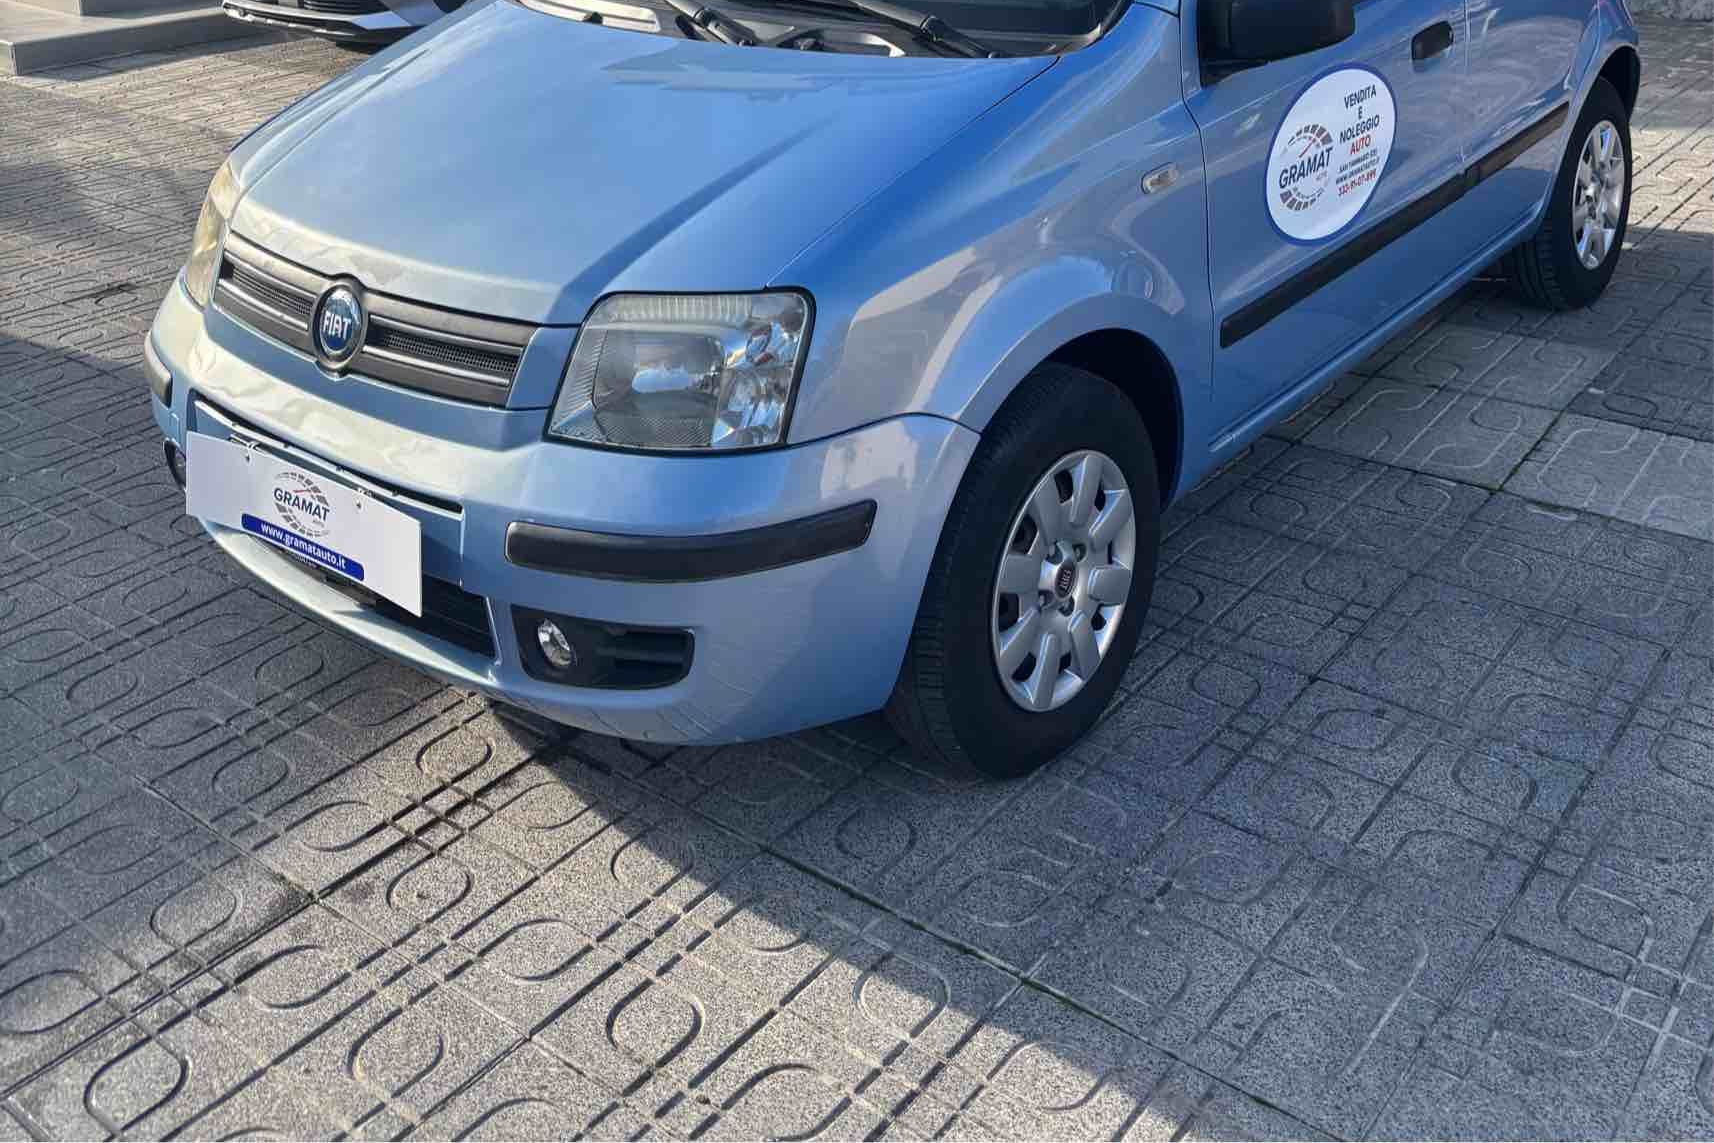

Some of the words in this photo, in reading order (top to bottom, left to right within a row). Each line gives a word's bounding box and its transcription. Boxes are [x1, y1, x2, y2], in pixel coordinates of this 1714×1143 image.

[1344, 84, 1377, 109] VENDITA
[1357, 106, 1363, 120] E
[1339, 114, 1380, 144] NOLEGGIO
[1350, 134, 1372, 155] AUTO
[1279, 147, 1333, 189] GRAMAT
[323, 311, 351, 340] FIAT
[273, 486, 331, 522] GRAMAT
[260, 523, 347, 570] www.gramatauto.it
